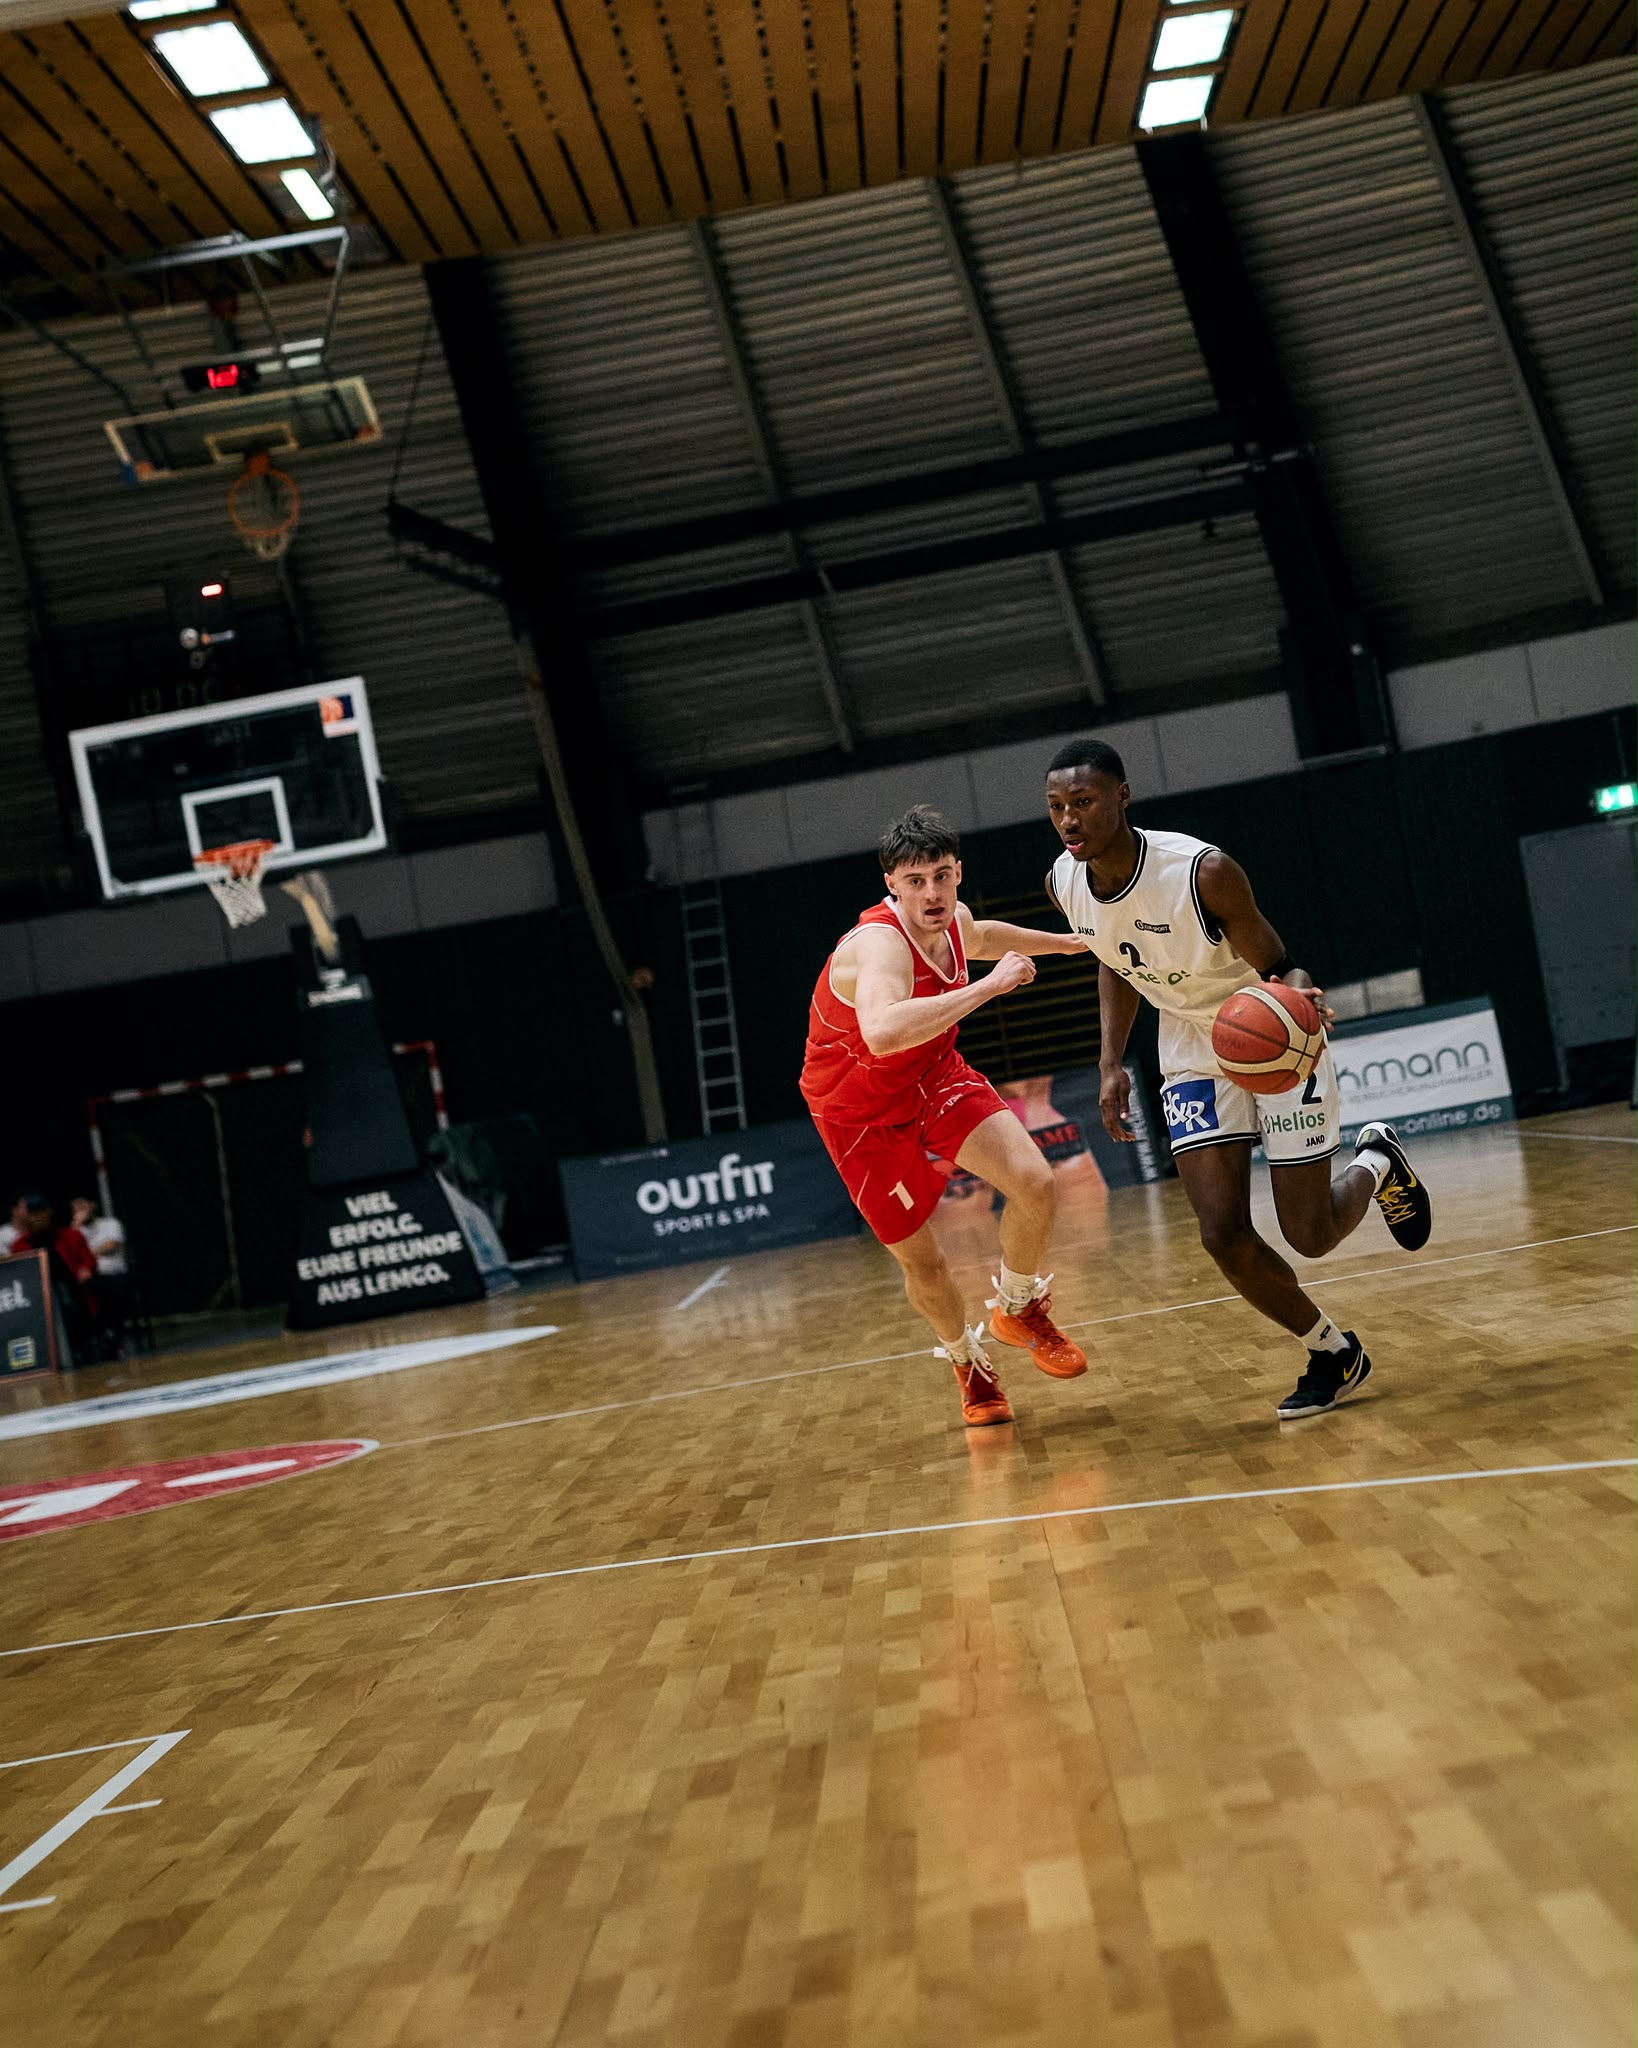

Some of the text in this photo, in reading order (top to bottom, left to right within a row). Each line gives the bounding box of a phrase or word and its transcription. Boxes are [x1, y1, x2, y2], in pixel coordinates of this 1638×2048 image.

[1118, 941, 1147, 969] 2
[1301, 1072, 1322, 1105] 2
[1271, 1110, 1325, 1134] Helios
[1305, 1134, 1325, 1148] JAKO
[345, 1190, 399, 1219] VIEL
[888, 1180, 915, 1211] 1
[328, 1212, 424, 1249] ERFOLG.
[653, 1202, 771, 1237] SPORT & SPA
[296, 1230, 463, 1281] EURE FREUNDE
[317, 1261, 451, 1306] AUS LEMGO.
